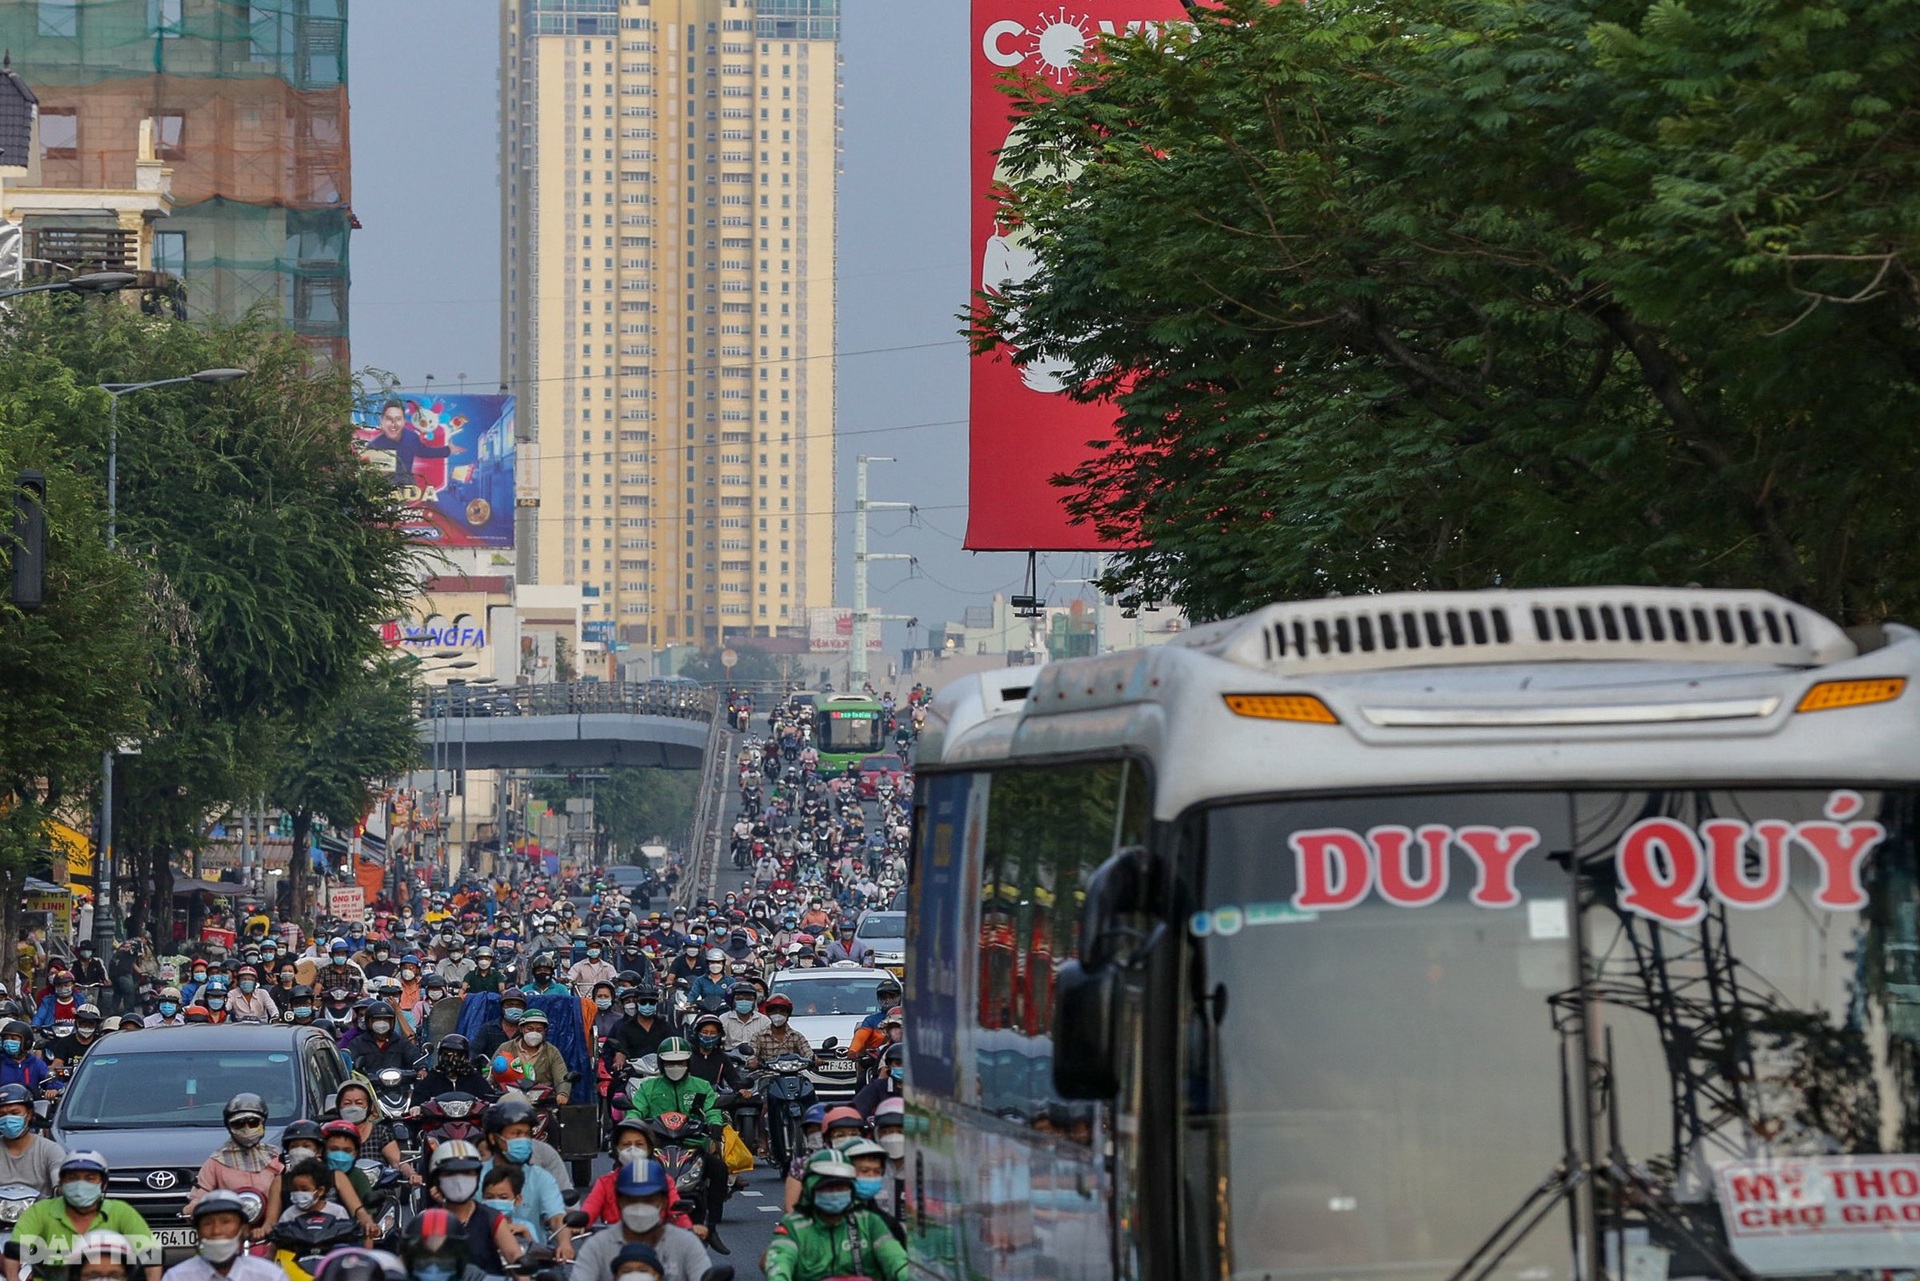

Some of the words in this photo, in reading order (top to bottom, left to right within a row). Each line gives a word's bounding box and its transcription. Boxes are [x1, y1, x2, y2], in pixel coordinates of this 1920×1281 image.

[405, 627, 484, 648] XINGFA
[1288, 825, 1541, 911] DUY
[1616, 789, 1886, 928] QUÝ
[42, 902, 65, 910] LINH
[1825, 1167, 1920, 1199] THO
